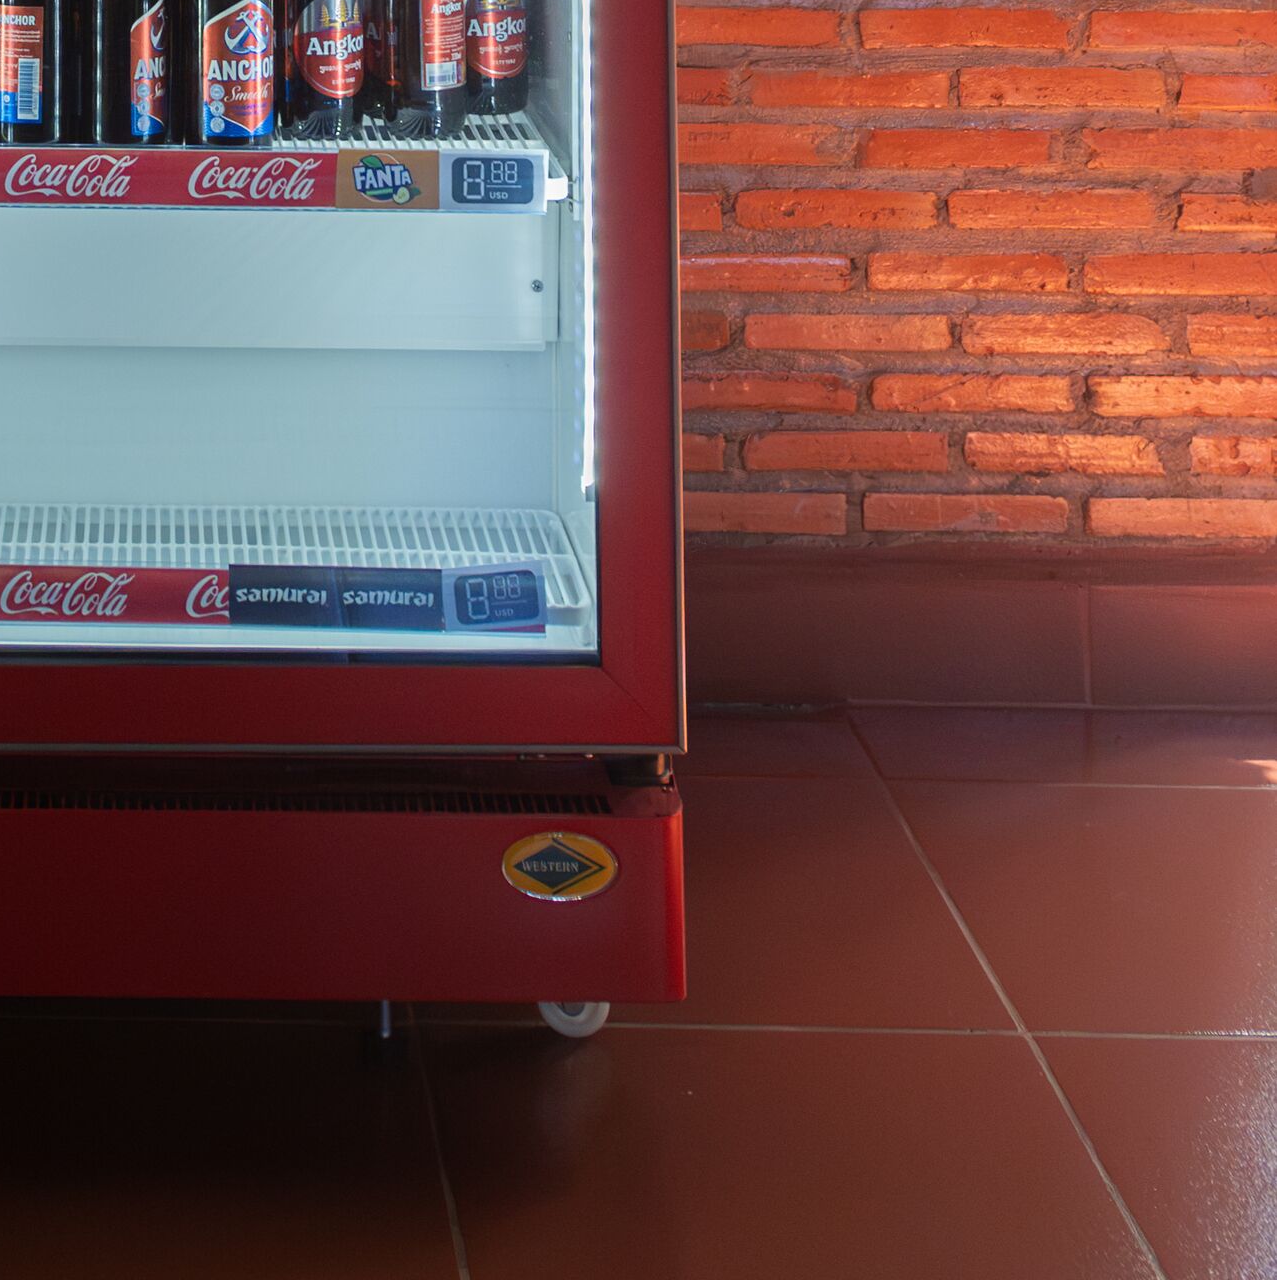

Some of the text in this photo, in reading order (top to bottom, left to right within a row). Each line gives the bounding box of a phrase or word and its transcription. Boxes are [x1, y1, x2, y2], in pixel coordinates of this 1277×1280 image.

[431, 2, 462, 16] Angkor
[224, 83, 270, 102] Smooth
[4, 153, 138, 198] Coca-Cola
[188, 155, 323, 200] Coca-Cola
[352, 164, 413, 189] FANTA
[489, 191, 509, 200] USD
[0, 570, 136, 617] Coca-Cola
[236, 586, 327, 605] samurai
[343, 588, 434, 608] samurai
[494, 608, 514, 618] USD
[522, 861, 579, 873] WESTERN
